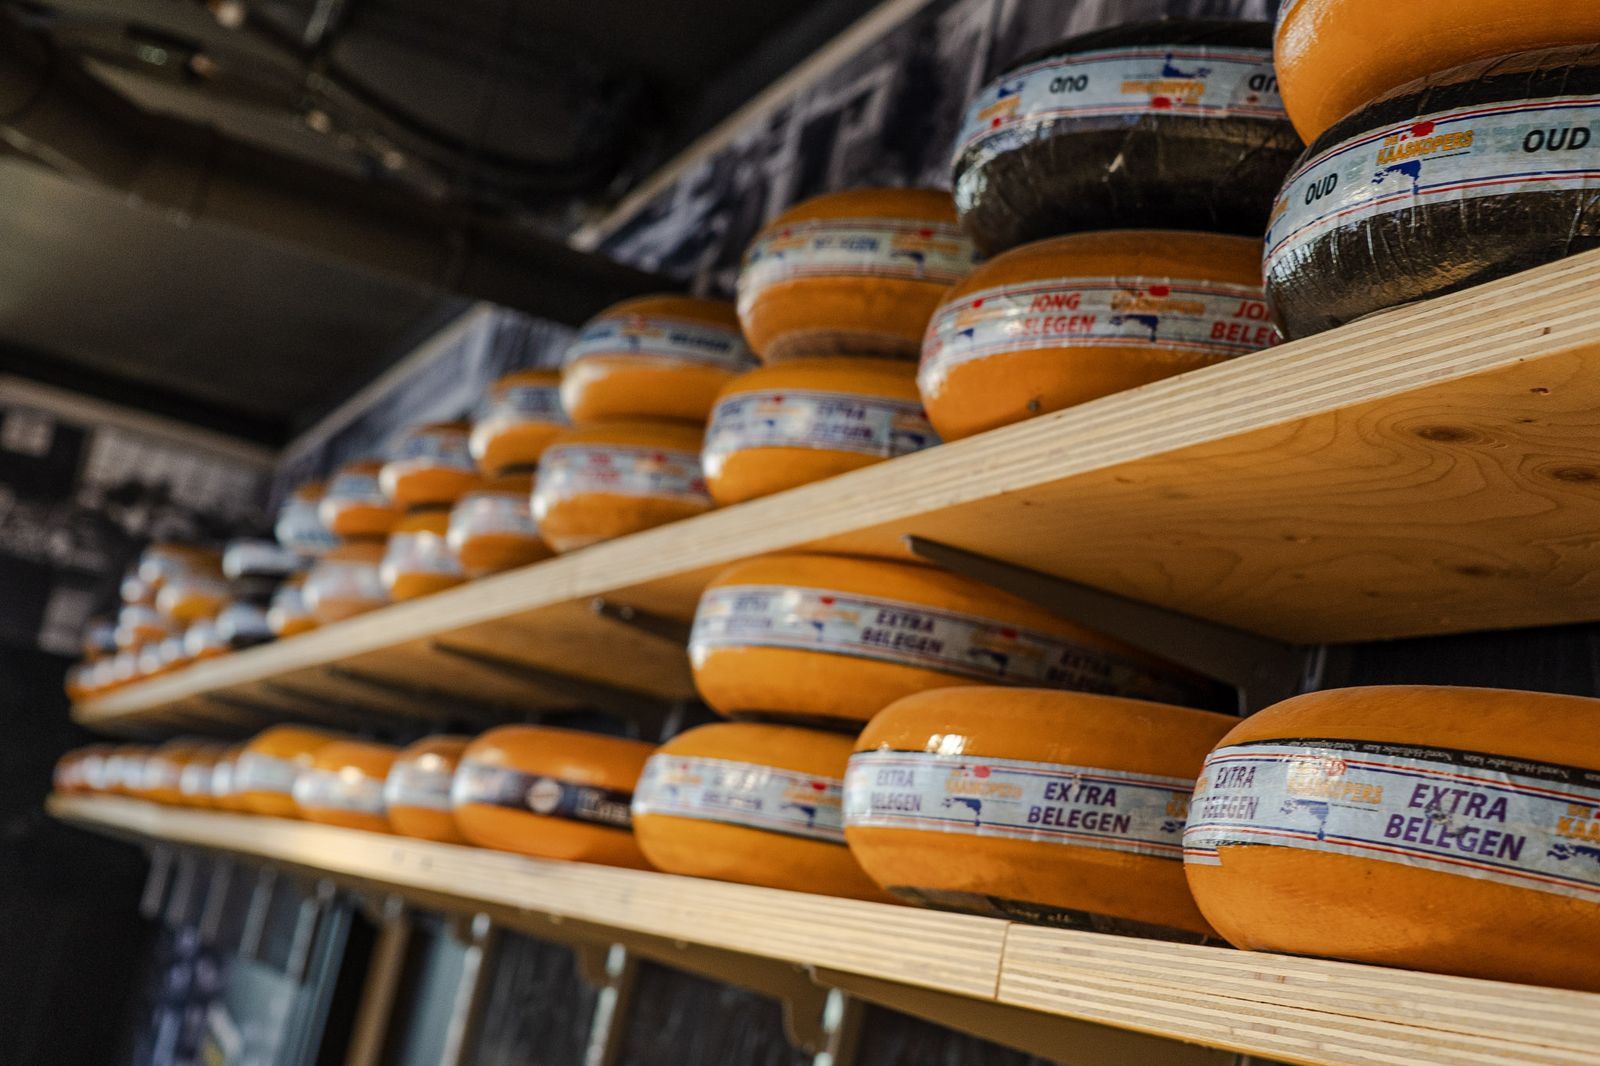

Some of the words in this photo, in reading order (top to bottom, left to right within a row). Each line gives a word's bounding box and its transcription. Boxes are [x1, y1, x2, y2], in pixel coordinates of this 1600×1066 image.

[1248, 73, 1280, 93] UD
[1376, 130, 1474, 166] KAASKOPERS
[1522, 126, 1592, 153] OUD
[1304, 172, 1339, 205] OUD
[1028, 292, 1082, 313] JONG
[1233, 300, 1270, 322] JO
[1213, 765, 1257, 789] EXTRA
[1043, 781, 1118, 807] EXTRA
[1407, 782, 1509, 823] EXTRA
[1027, 805, 1132, 834] BELEGEN
[1383, 813, 1527, 862] BELEGEN
